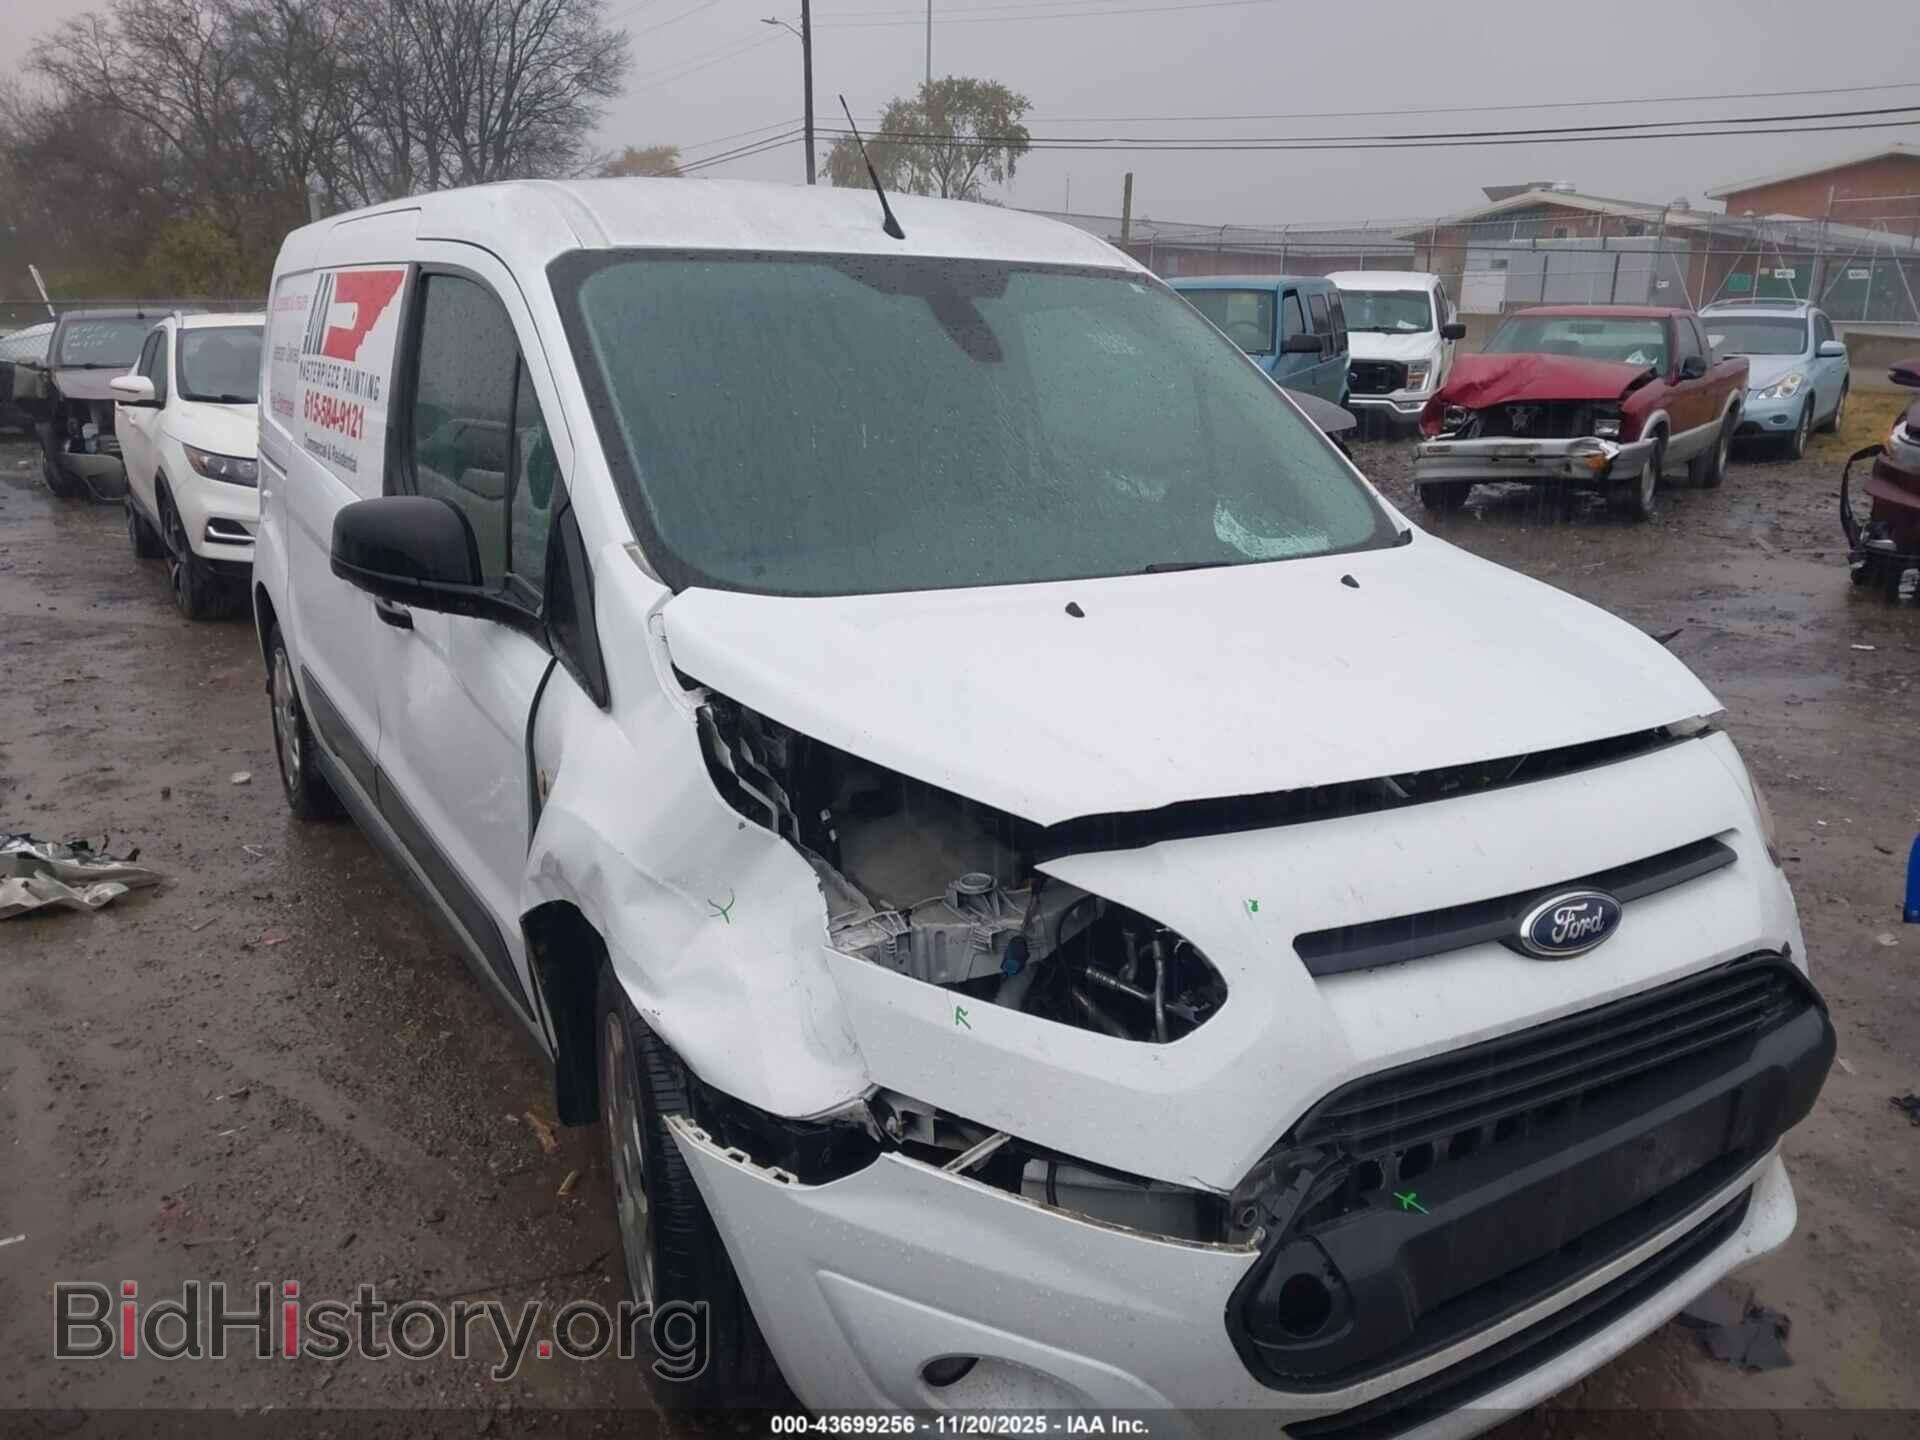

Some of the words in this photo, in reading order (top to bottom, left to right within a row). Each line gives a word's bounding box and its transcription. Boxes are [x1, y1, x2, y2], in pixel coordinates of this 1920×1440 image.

[342, 367, 381, 401] PAINTING
[303, 388, 365, 441] 615-584-9121
[1551, 902, 1604, 944] Ford
